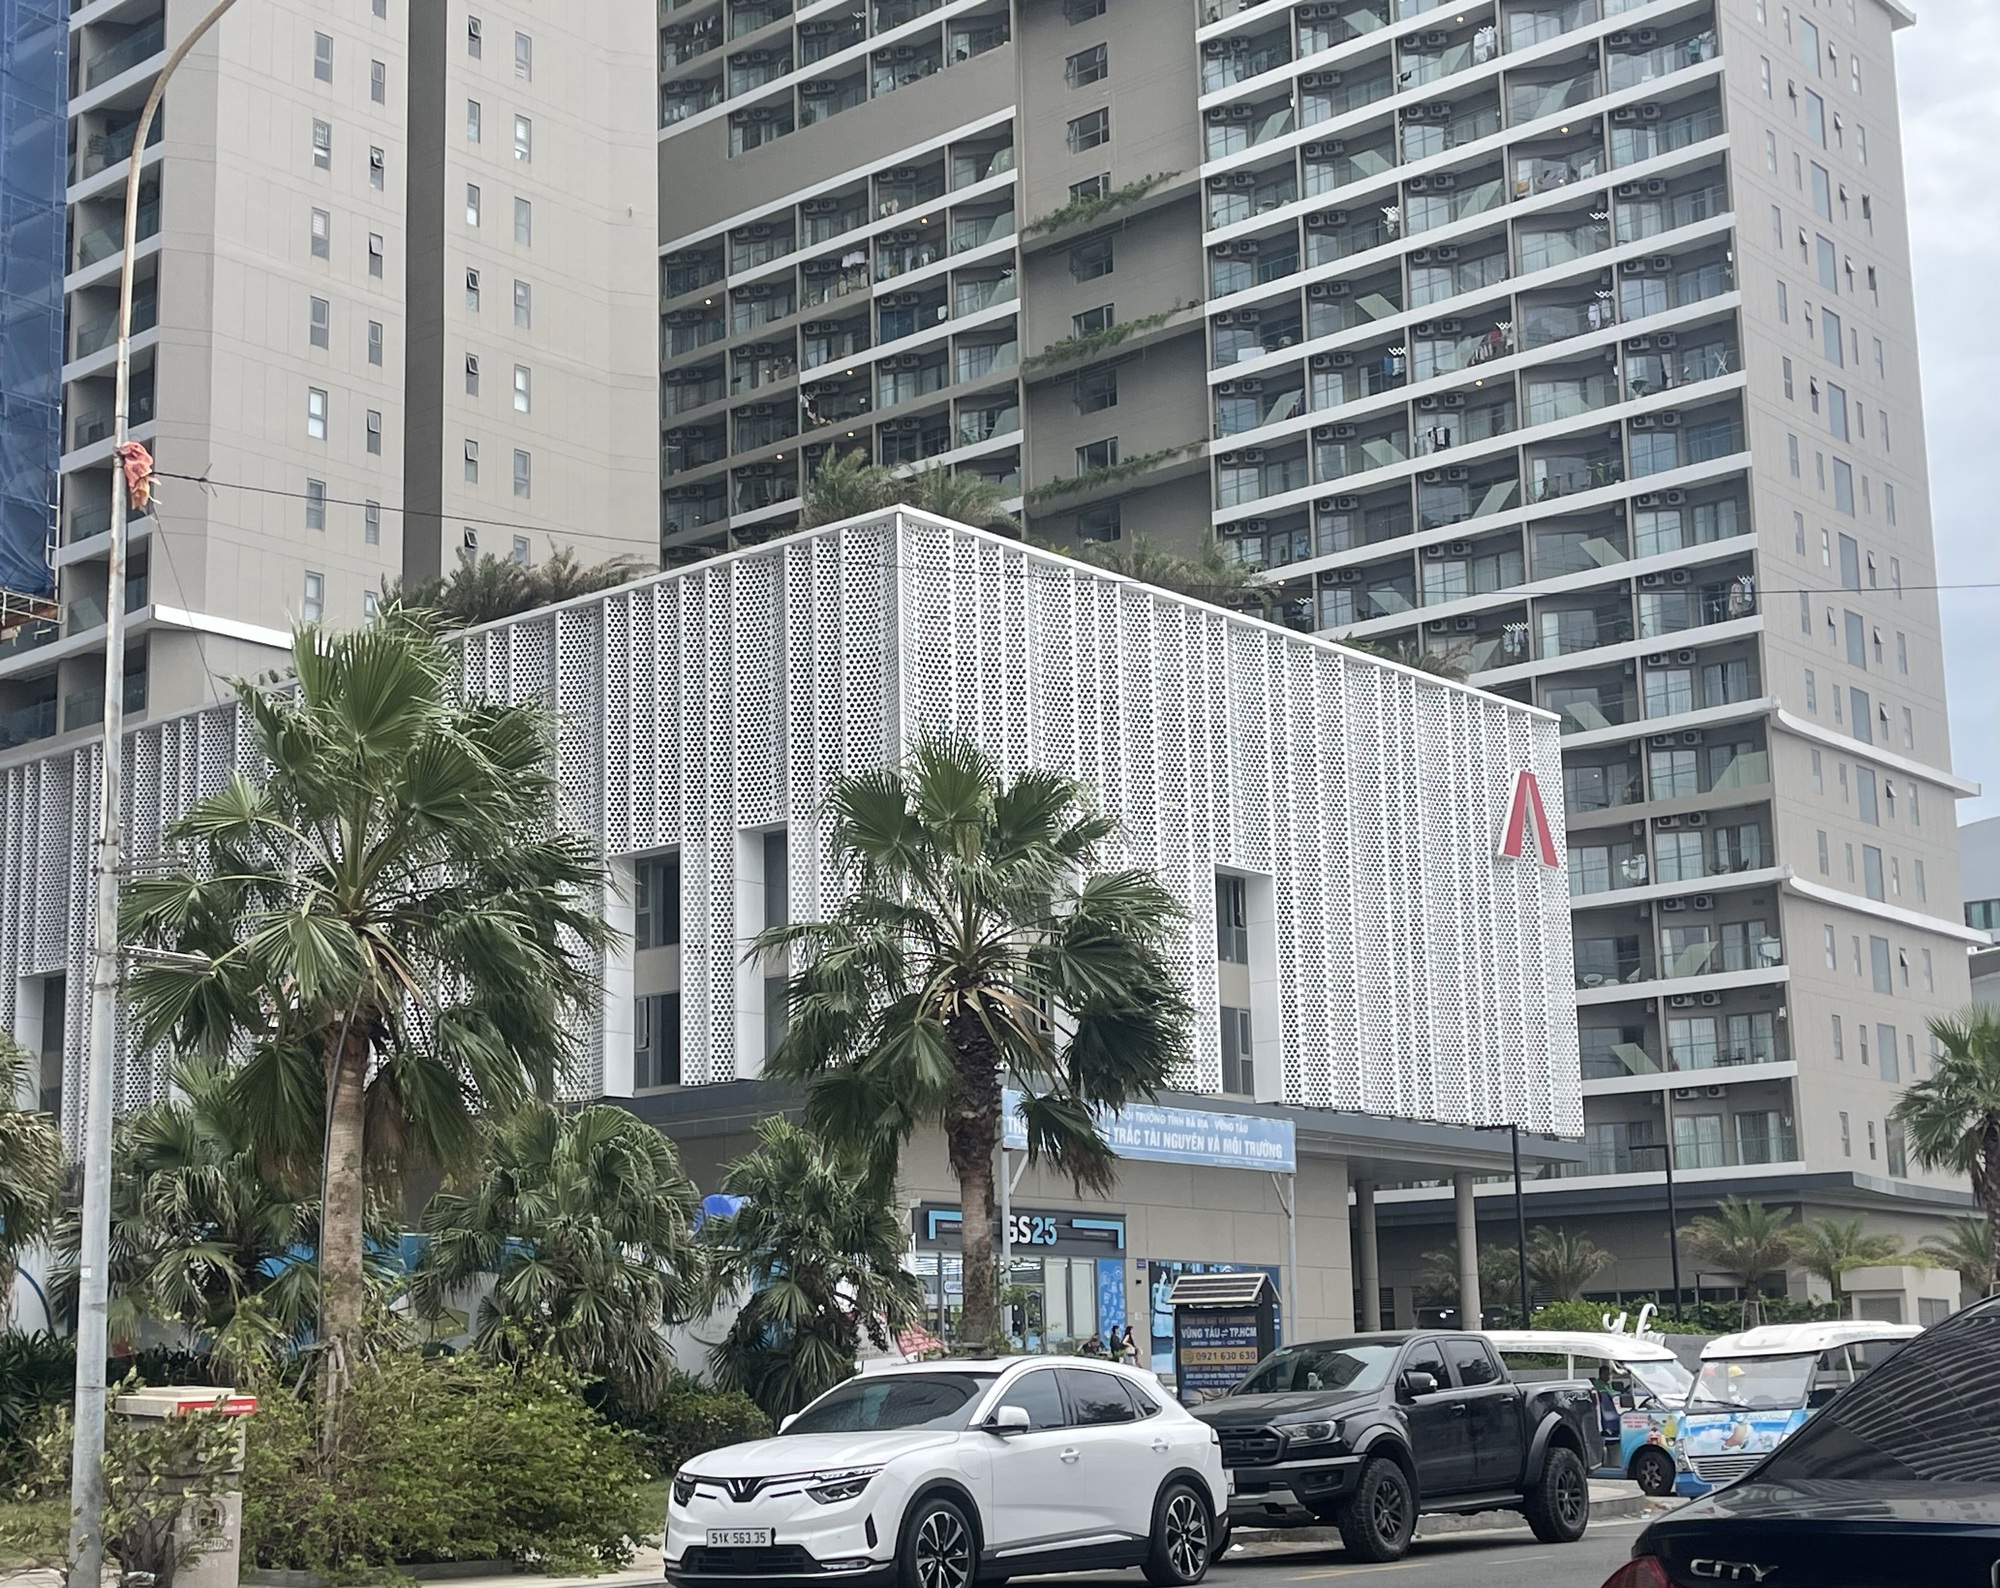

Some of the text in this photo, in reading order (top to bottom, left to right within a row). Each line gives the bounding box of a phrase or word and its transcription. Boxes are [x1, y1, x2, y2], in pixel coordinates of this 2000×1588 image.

[1113, 1123, 1141, 1145] TRẮC
[1143, 1127, 1160, 1146] TÀI
[1163, 1131, 1205, 1152] NGUYÊN
[1207, 1134, 1220, 1153] VÀ
[1223, 1136, 1242, 1155] MÔI
[1244, 1138, 1282, 1159] TRƯỜNG
[1008, 1215, 1058, 1246] GS25
[1181, 1325, 1257, 1339] VŨNG TÀU TP.HCM
[1196, 1351, 1256, 1361] 0921 630 630
[711, 1532, 766, 1544] 51K 563.35
[1690, 1559, 1779, 1582] CITY
